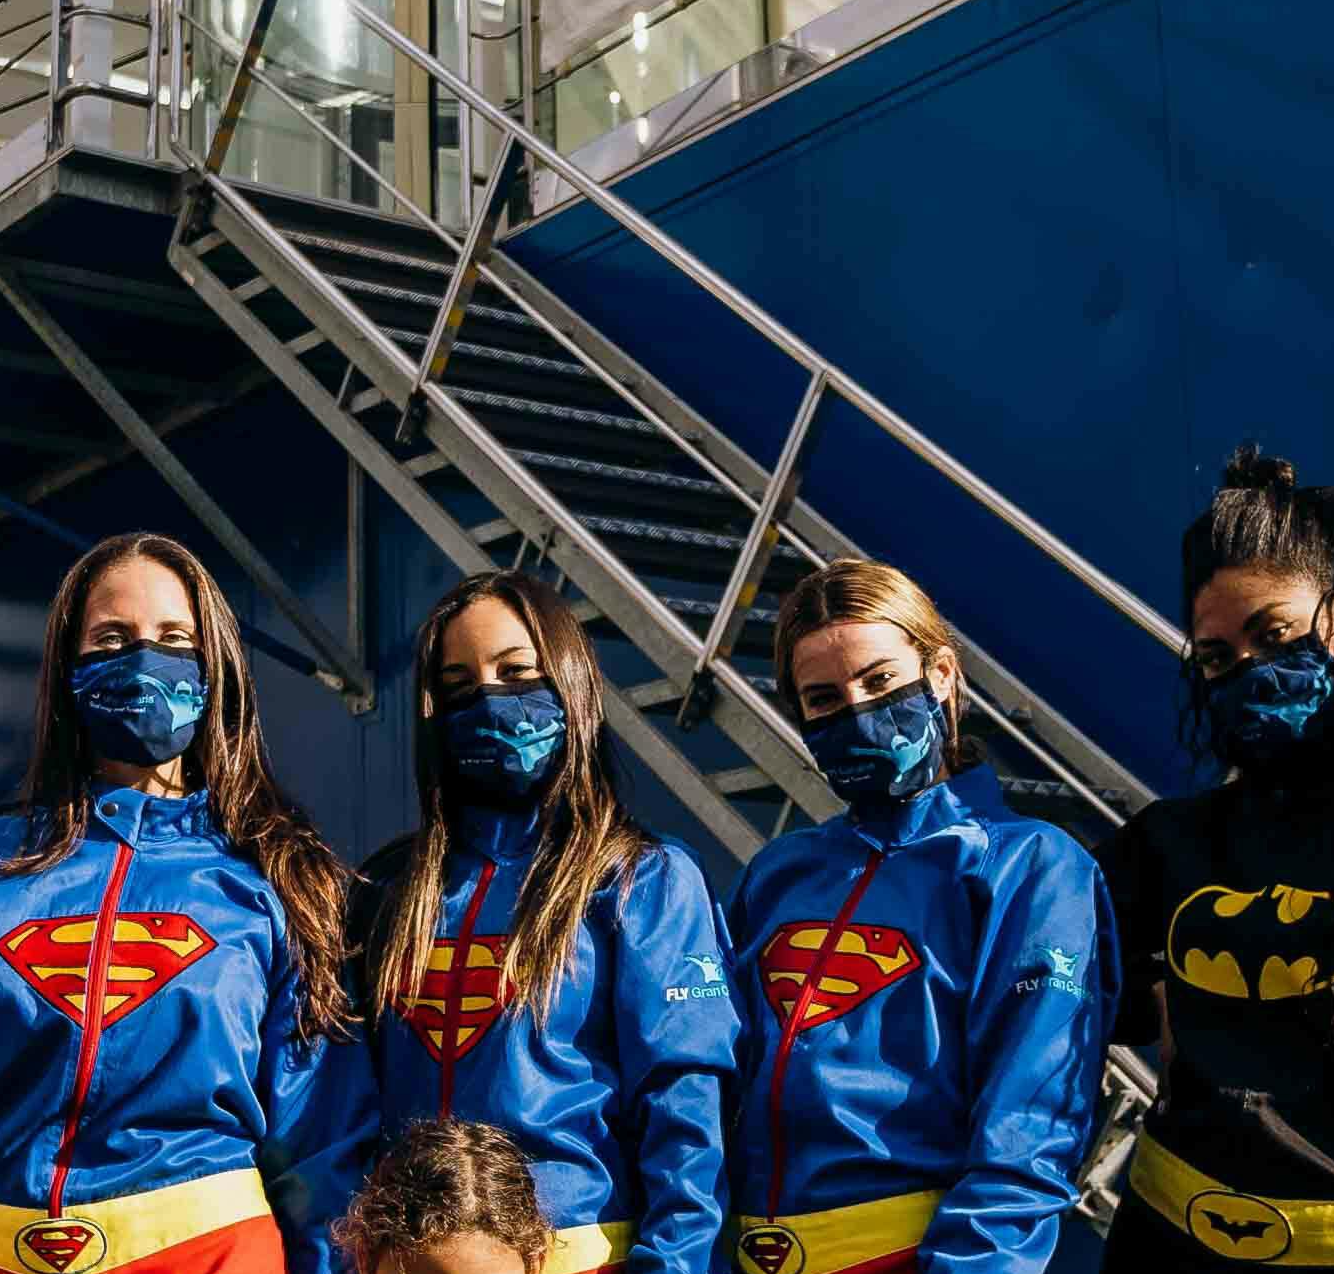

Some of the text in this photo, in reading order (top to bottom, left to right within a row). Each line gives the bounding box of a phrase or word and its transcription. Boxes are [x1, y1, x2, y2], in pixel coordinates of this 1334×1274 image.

[1015, 977, 1040, 994] FLY
[665, 986, 689, 1002] FLY
[690, 986, 722, 999] Gran
